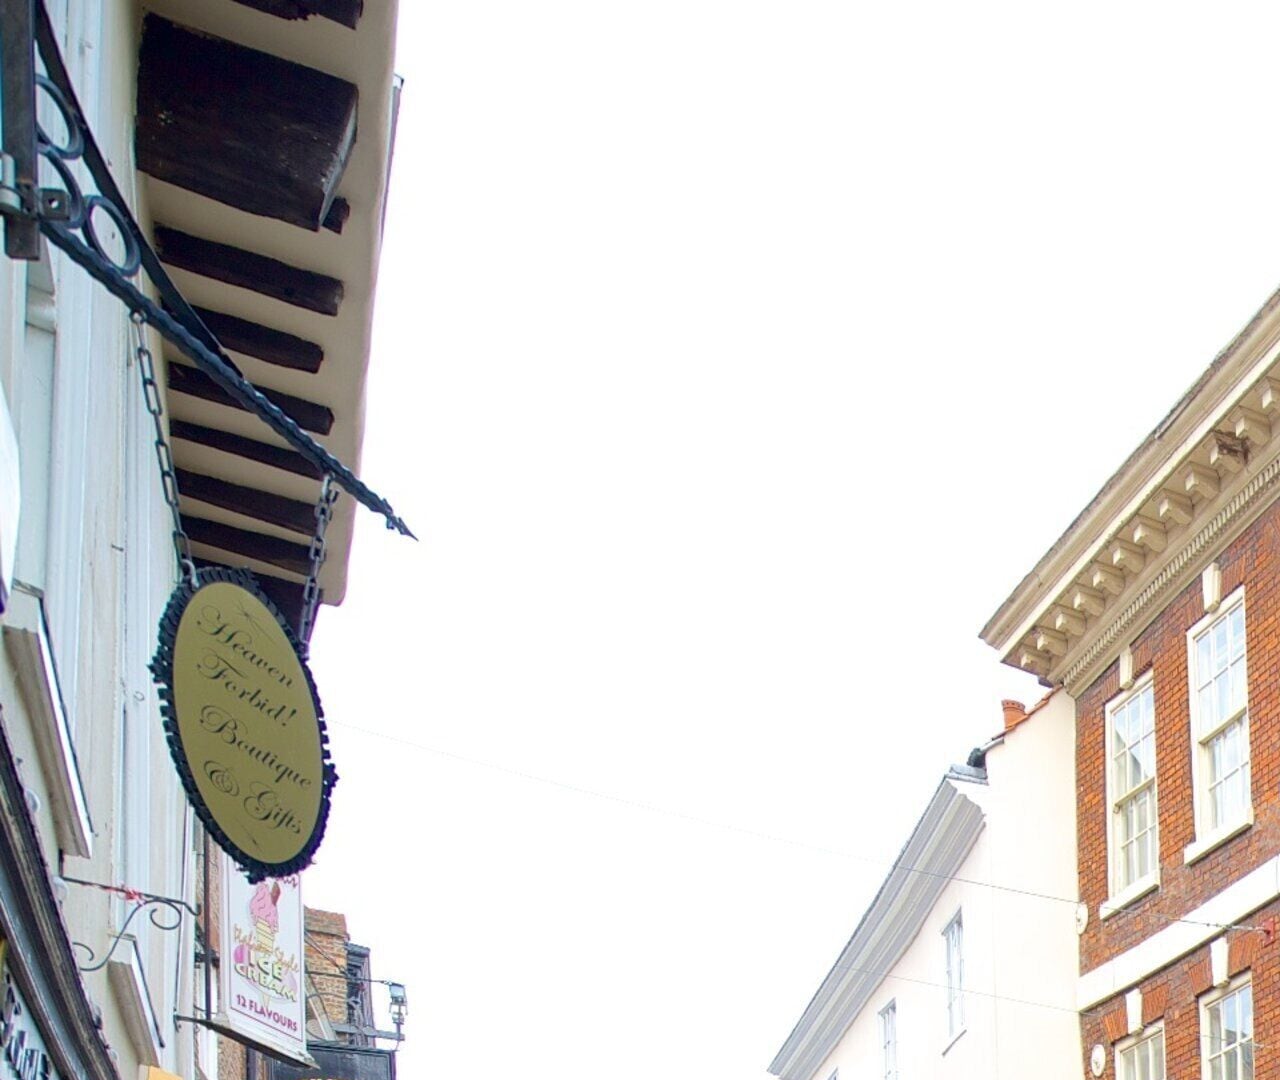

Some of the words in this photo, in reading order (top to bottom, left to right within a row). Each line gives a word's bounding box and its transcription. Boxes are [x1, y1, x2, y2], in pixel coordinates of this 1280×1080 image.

[197, 604, 294, 688] Heaven
[197, 646, 297, 727] Forbid!
[200, 704, 311, 788] Boutique
[203, 760, 240, 797] &
[243, 781, 302, 835] Gifts
[234, 962, 297, 1003] CREAM
[248, 952, 283, 982] ICE
[249, 1000, 298, 1032] FLAVOURS
